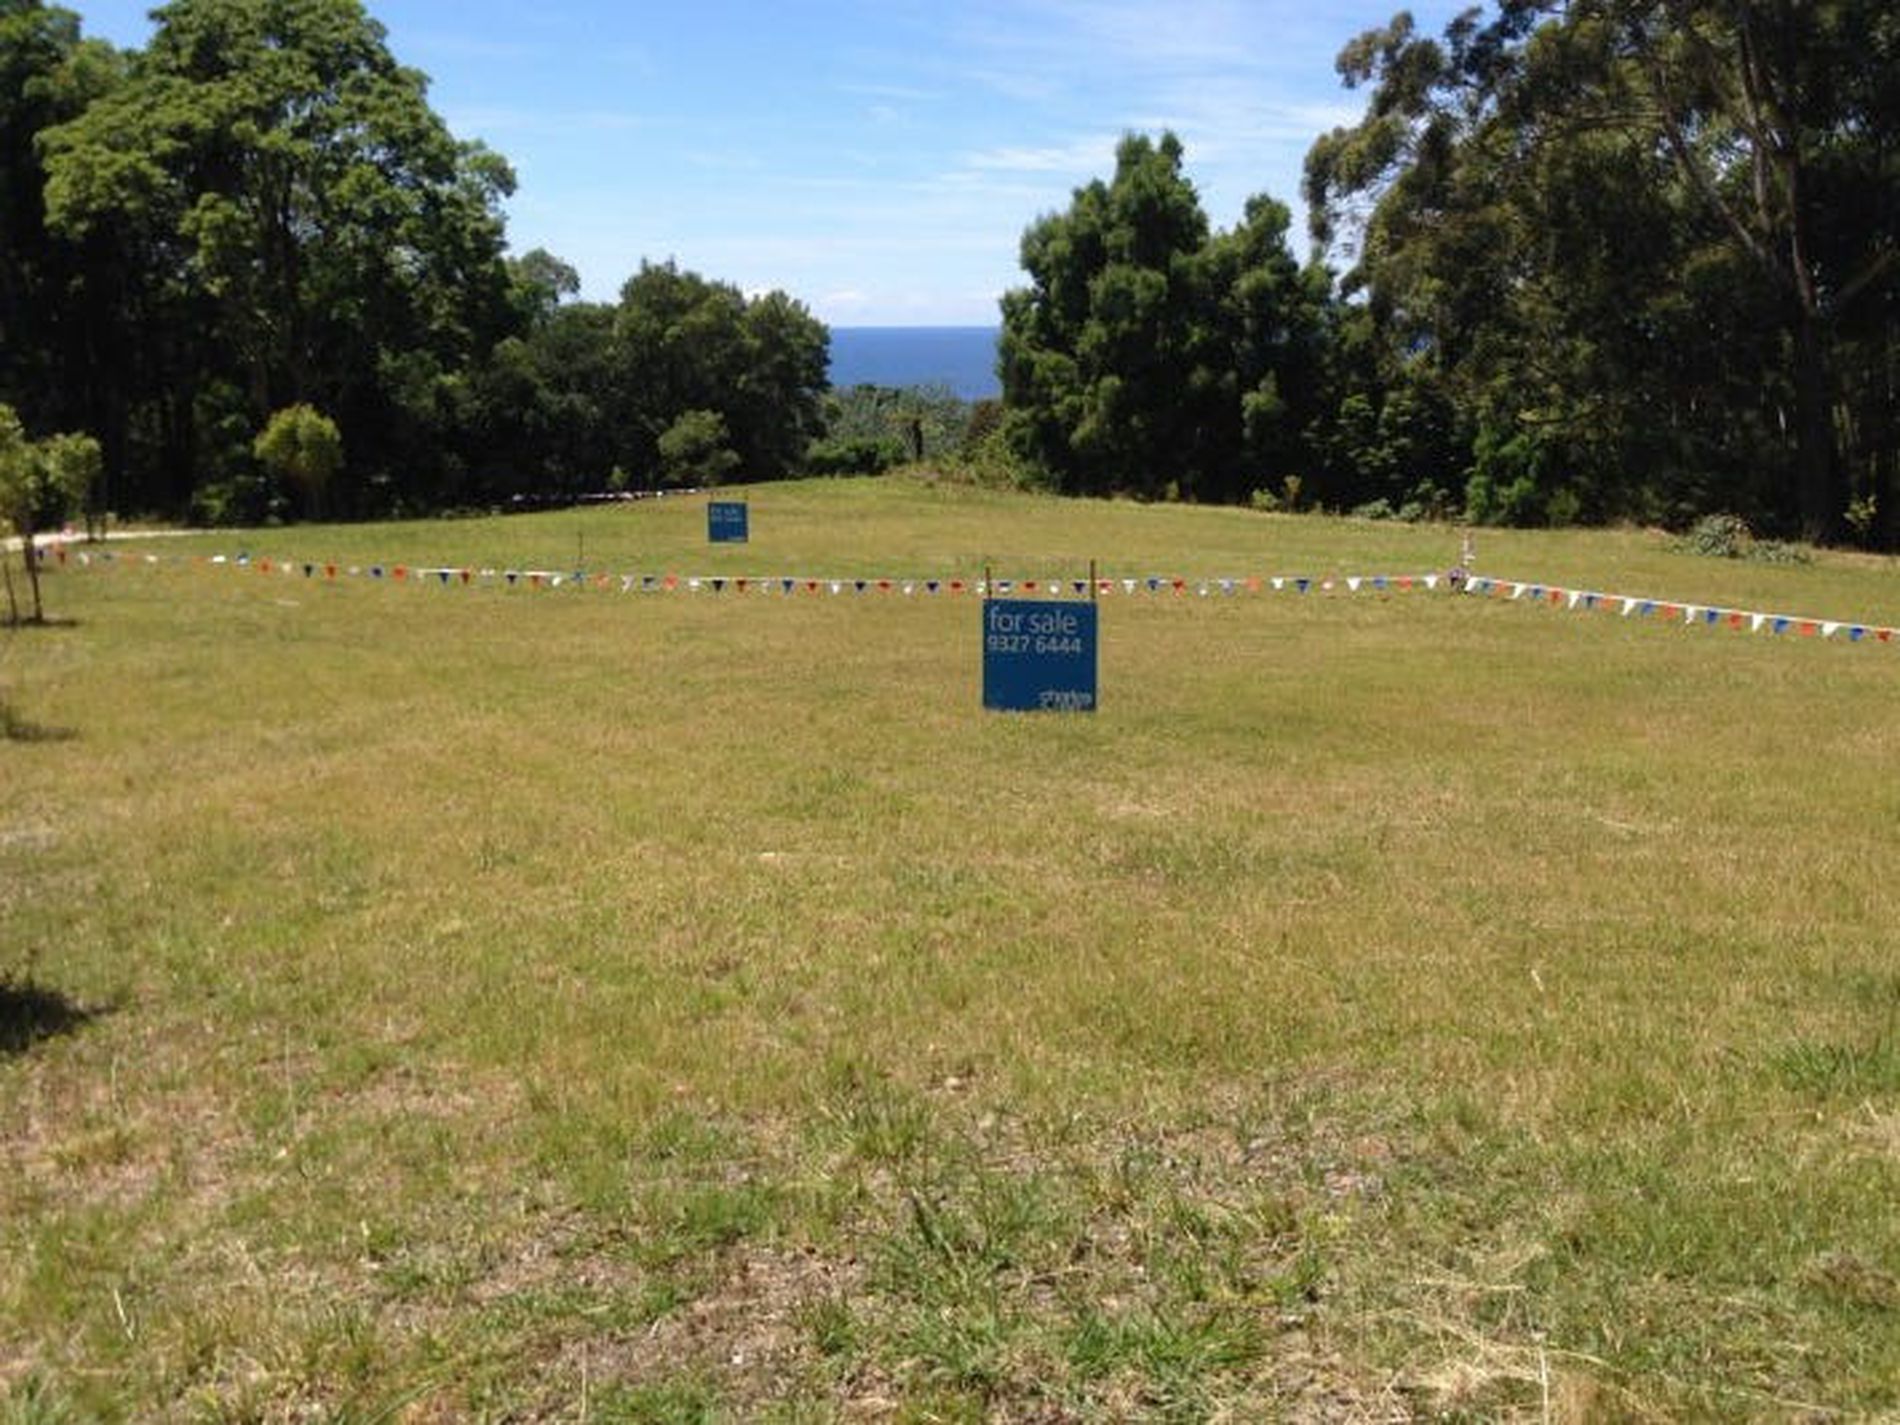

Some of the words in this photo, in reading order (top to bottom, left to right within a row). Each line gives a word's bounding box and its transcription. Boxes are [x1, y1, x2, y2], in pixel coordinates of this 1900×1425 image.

[989, 606, 1022, 632] for
[1029, 608, 1078, 634] sale
[987, 635, 1031, 653] 9327
[1035, 636, 1081, 654] 6444
